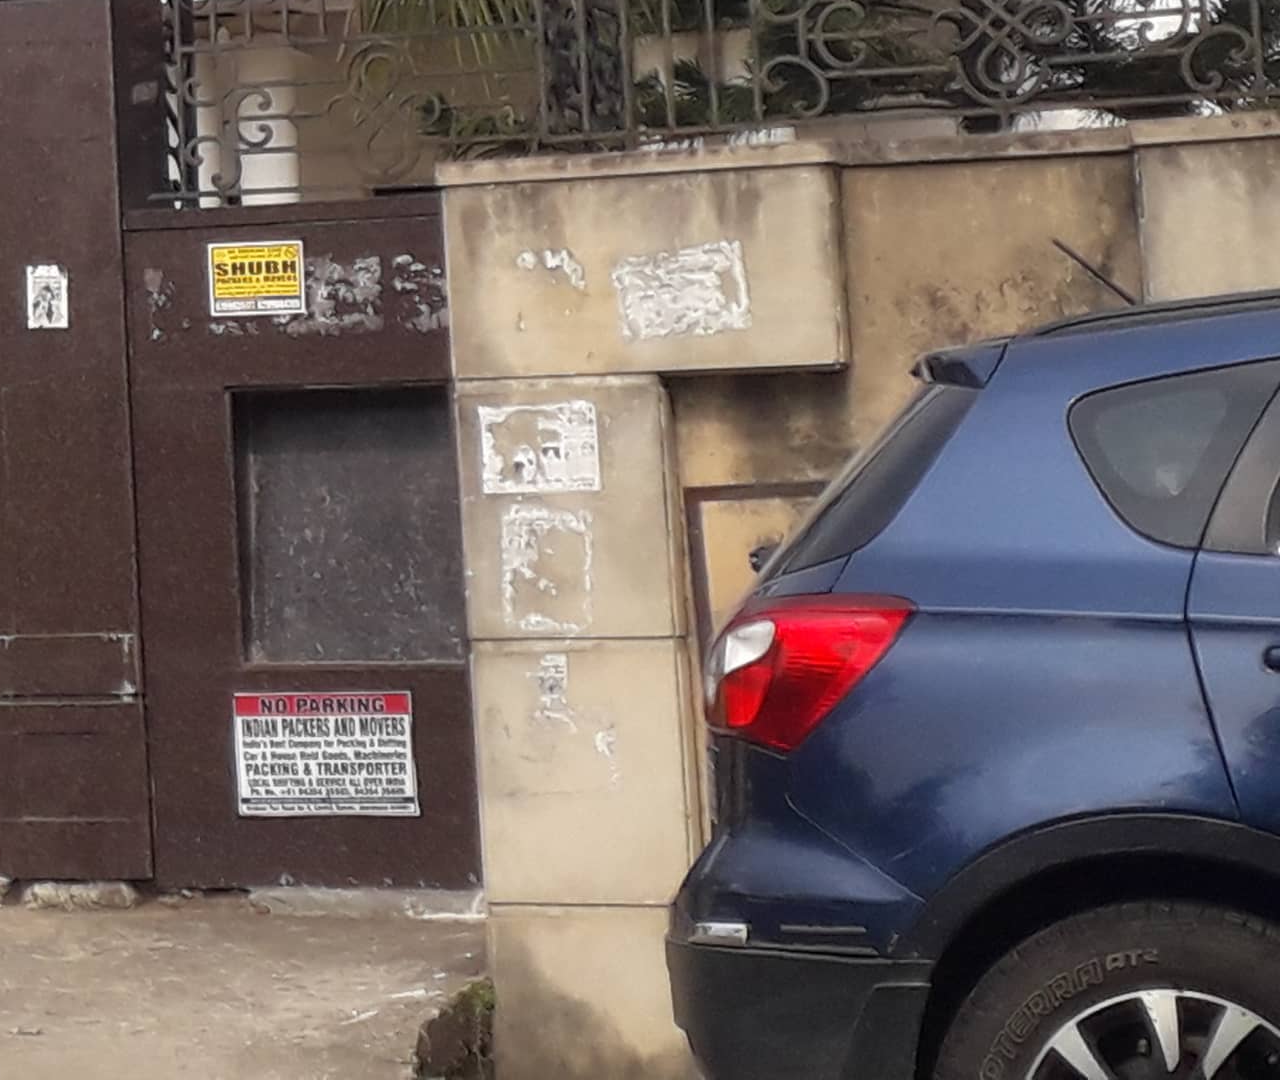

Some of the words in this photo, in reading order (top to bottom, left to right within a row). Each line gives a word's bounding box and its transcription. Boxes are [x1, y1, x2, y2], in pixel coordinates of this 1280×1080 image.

[215, 260, 297, 277] SHUBH
[260, 698, 288, 713] NO
[296, 697, 385, 713] PARKING
[242, 718, 278, 737] INDIAN
[282, 717, 330, 737] PACKERS
[334, 717, 356, 736] AND
[359, 717, 406, 736] MOVERS
[245, 763, 299, 777] PACKING
[304, 763, 312, 776] &
[316, 762, 407, 775] TRANSPORTER
